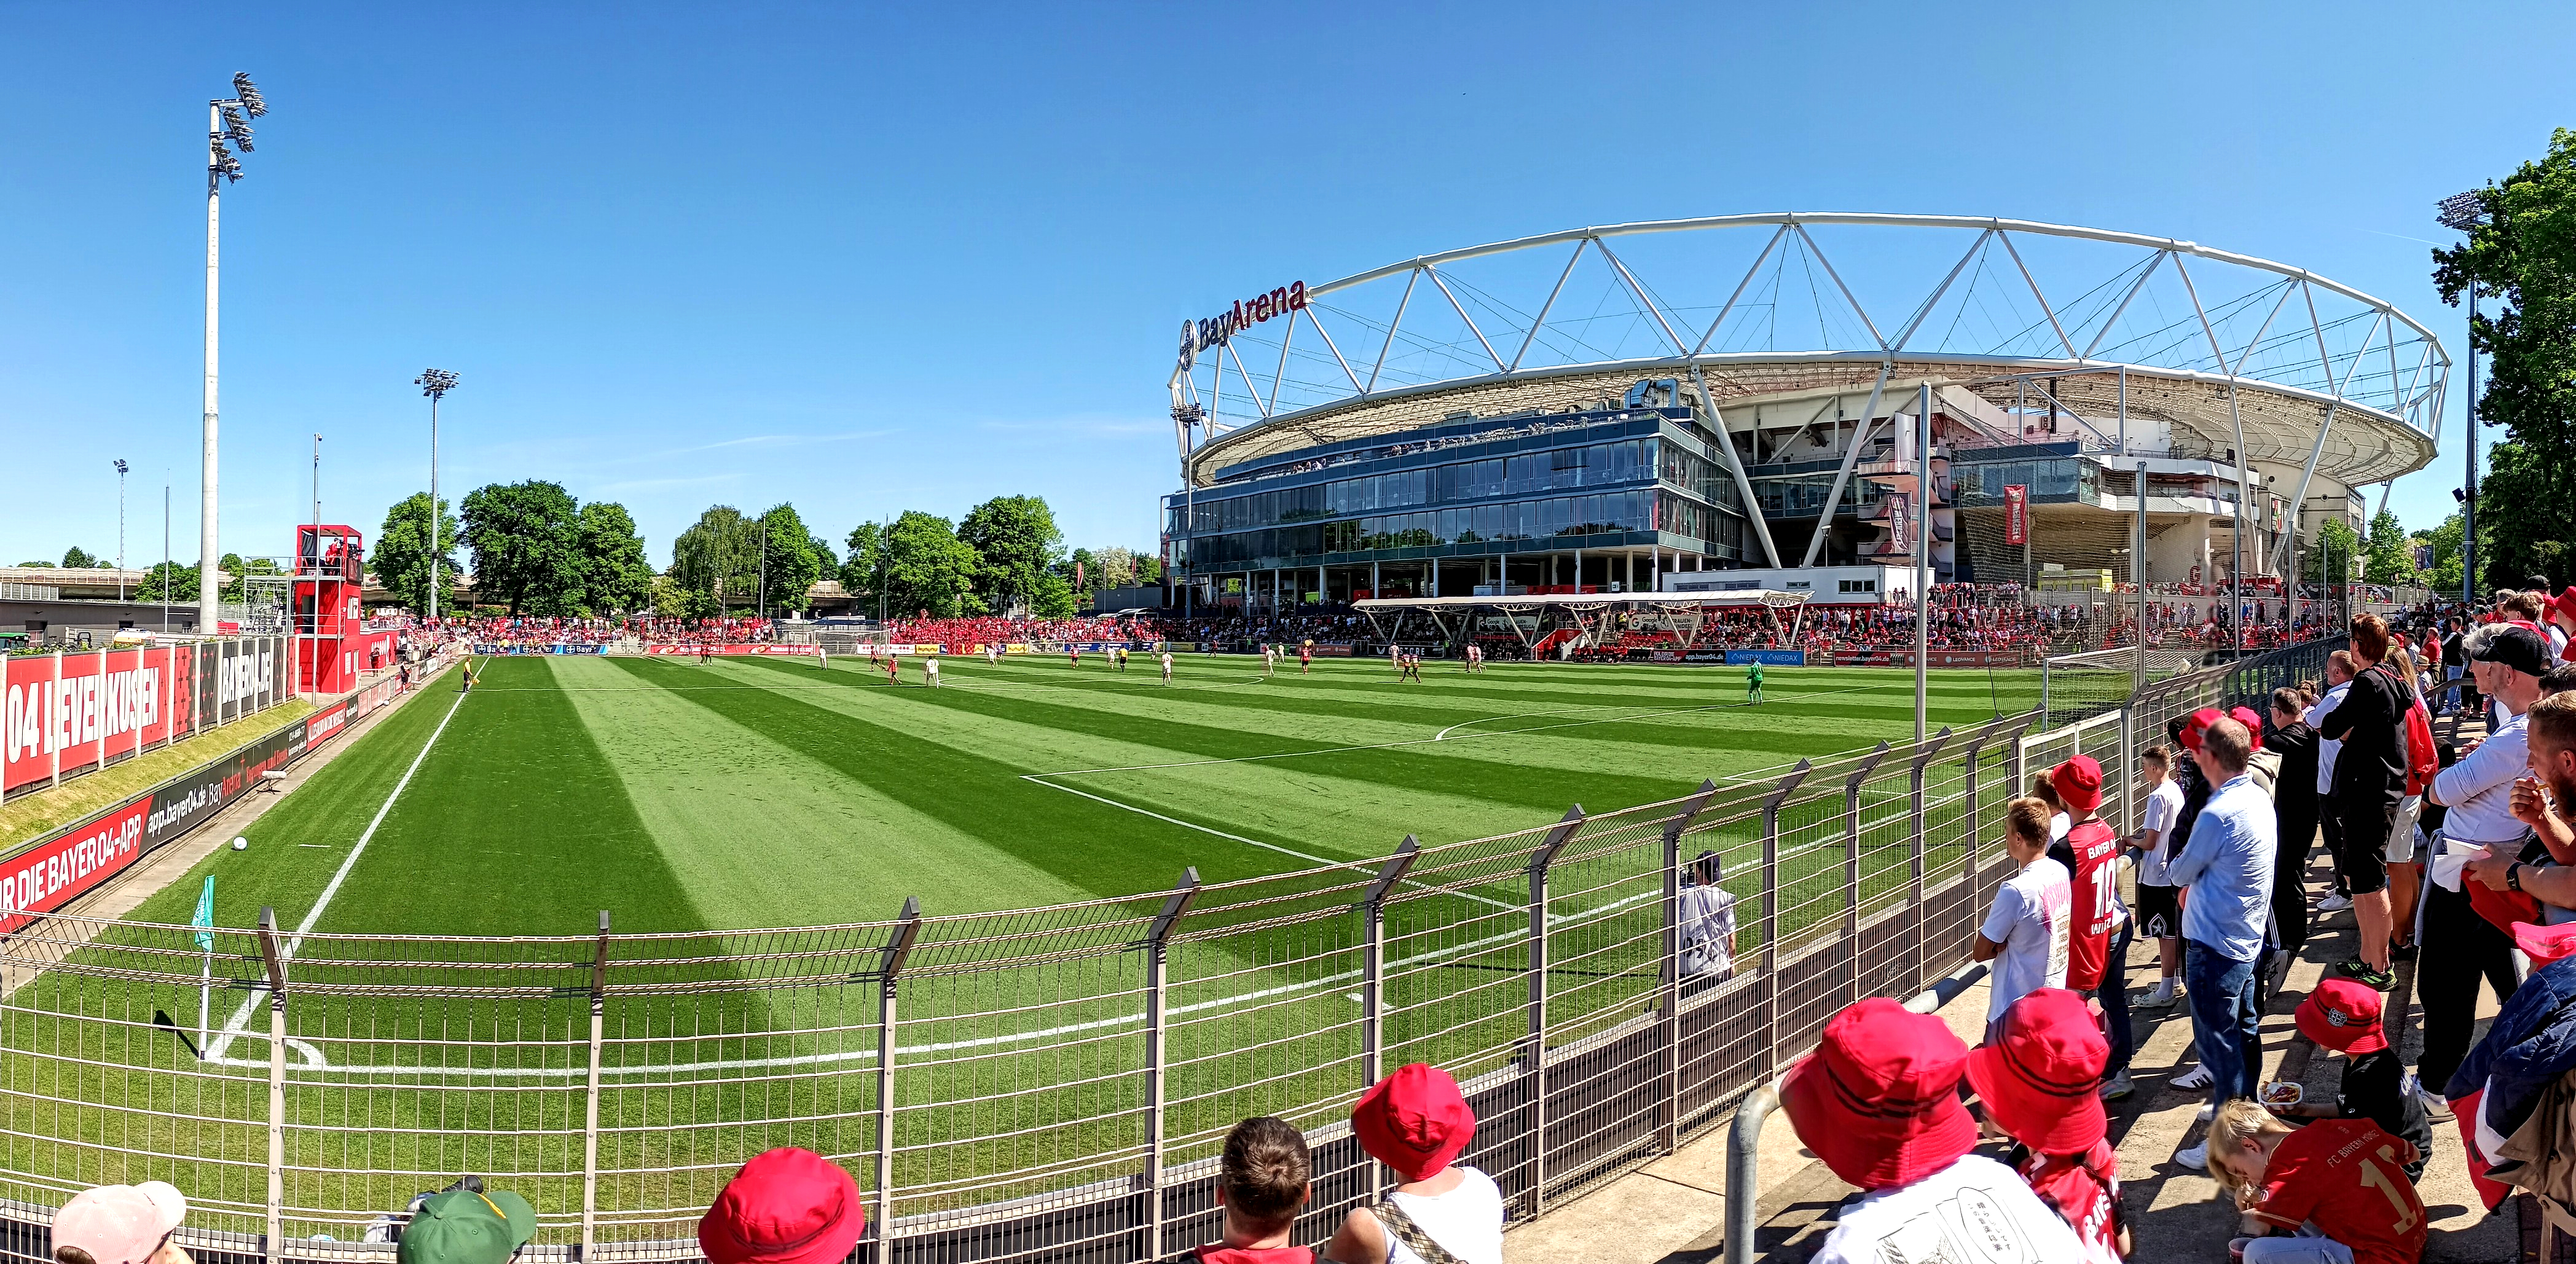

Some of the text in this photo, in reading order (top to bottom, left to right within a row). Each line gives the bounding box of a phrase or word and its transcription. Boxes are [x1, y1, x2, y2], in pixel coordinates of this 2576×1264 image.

[1198, 280, 1309, 353] BayArena
[1836, 654, 1890, 663] newsletter.bayer04.de
[7, 682, 40, 764] 04
[147, 783, 206, 838] app.bayer04.de
[208, 771, 242, 807] BayArena
[0, 812, 142, 923] R DIE BAYER 04-APP
[2087, 843, 2111, 860] BAYER
[2091, 857, 2117, 920] 10
[2327, 1155, 2341, 1168] FC
[2338, 1137, 2365, 1158] BAYERN
